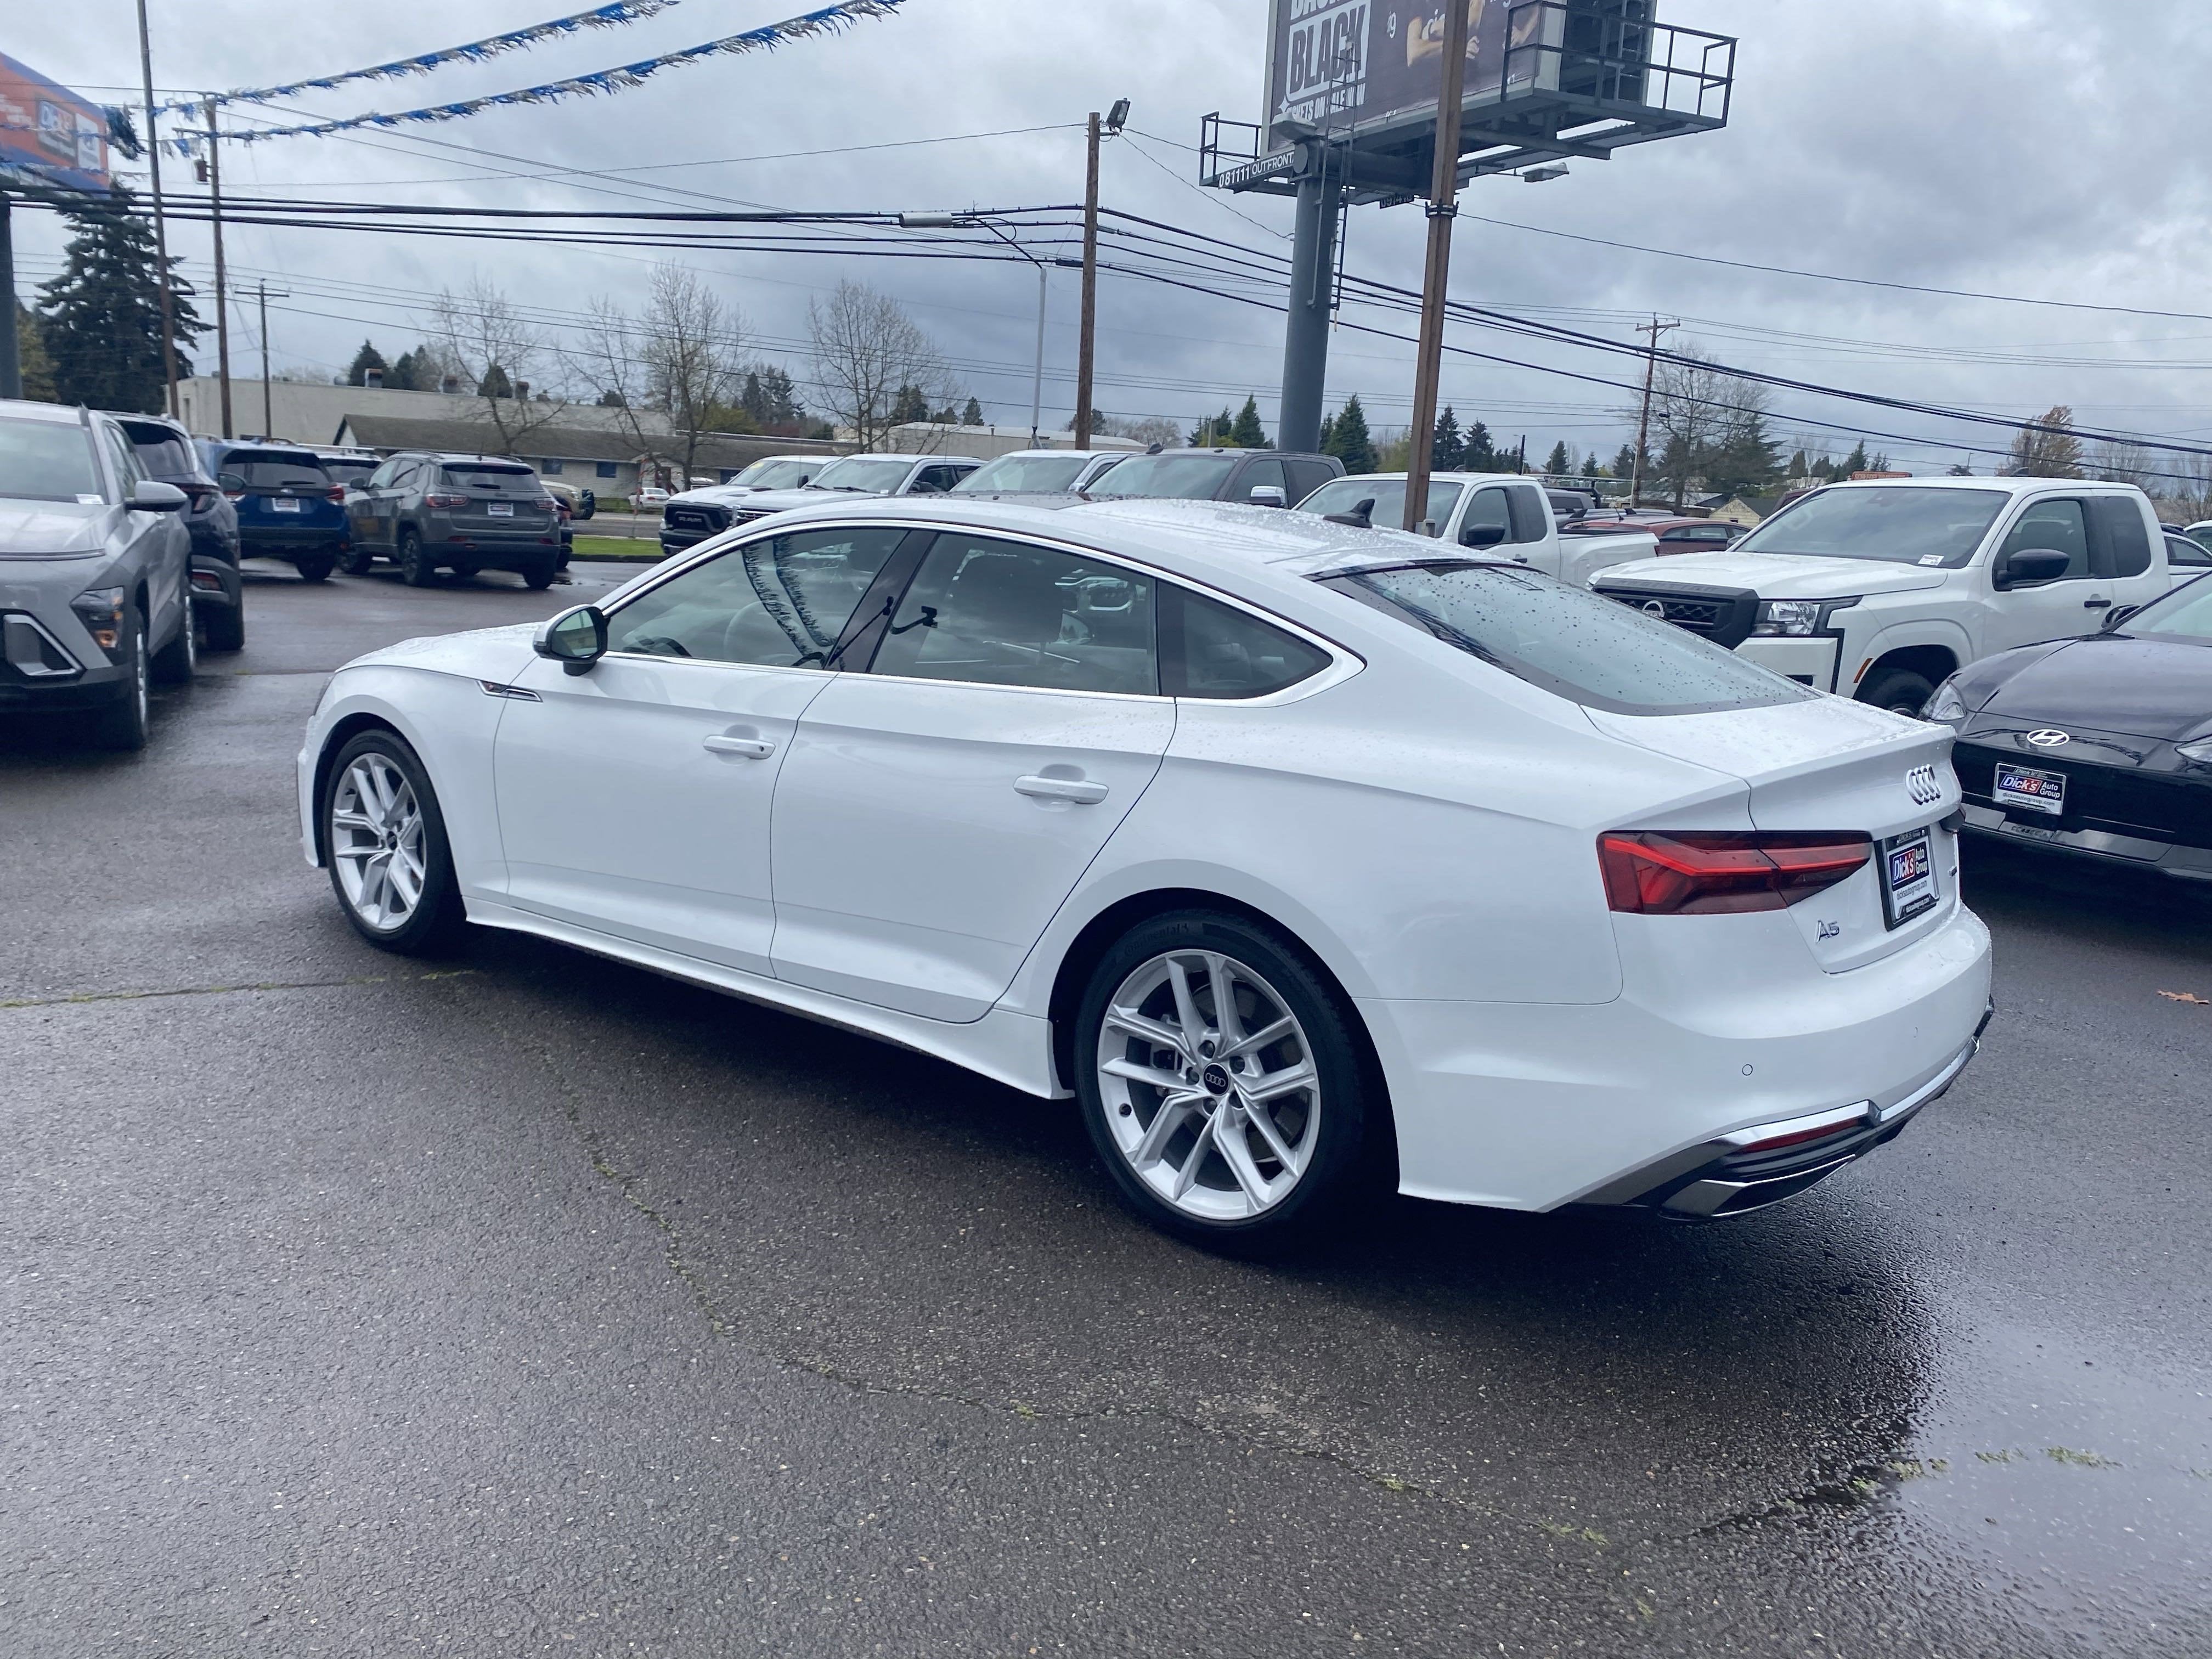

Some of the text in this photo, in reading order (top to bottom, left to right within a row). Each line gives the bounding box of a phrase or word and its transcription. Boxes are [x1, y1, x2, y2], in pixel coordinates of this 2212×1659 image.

[1289, 4, 1366, 94] BLACK
[1314, 95, 1326, 119] ON
[1219, 165, 1250, 188] 081111
[2003, 776, 2058, 791] Dick's Auto
[2039, 788, 2061, 799] Group
[1893, 847, 1925, 881] Dick's Auto
[1915, 861, 1928, 874] Group
[1815, 919, 1839, 943] A5
